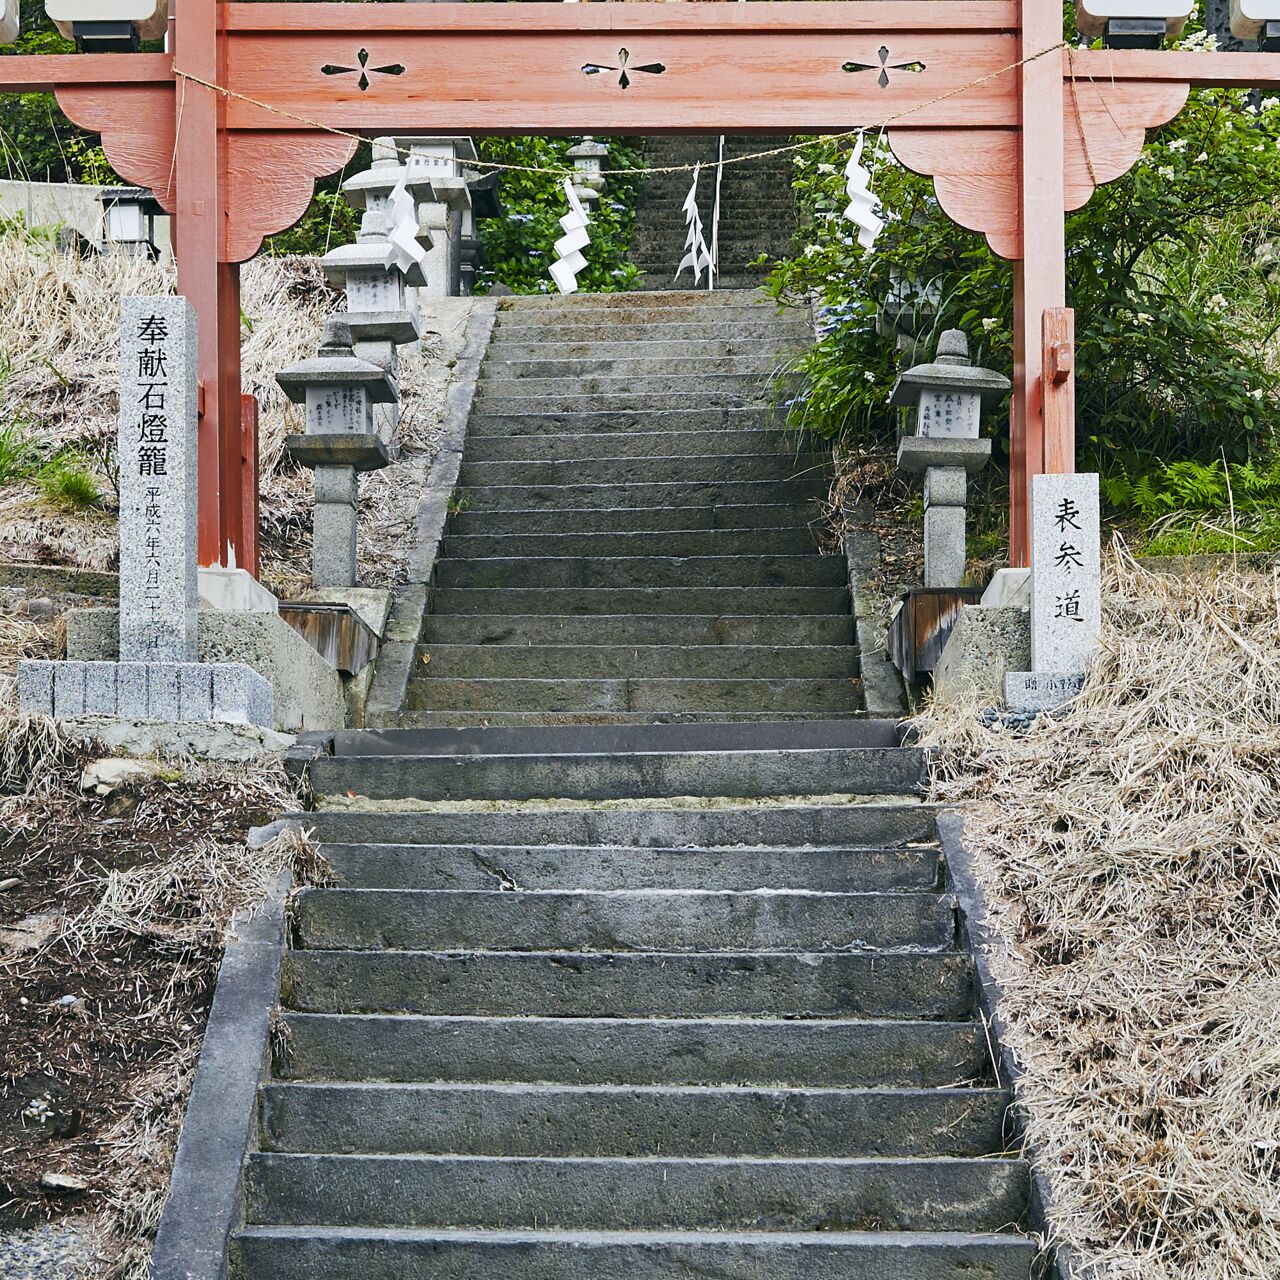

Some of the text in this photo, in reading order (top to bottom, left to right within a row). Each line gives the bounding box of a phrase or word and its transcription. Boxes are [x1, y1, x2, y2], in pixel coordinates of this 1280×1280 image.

[136, 314, 169, 477] 奉献石燈籠
[1053, 497, 1085, 623] 表参道
